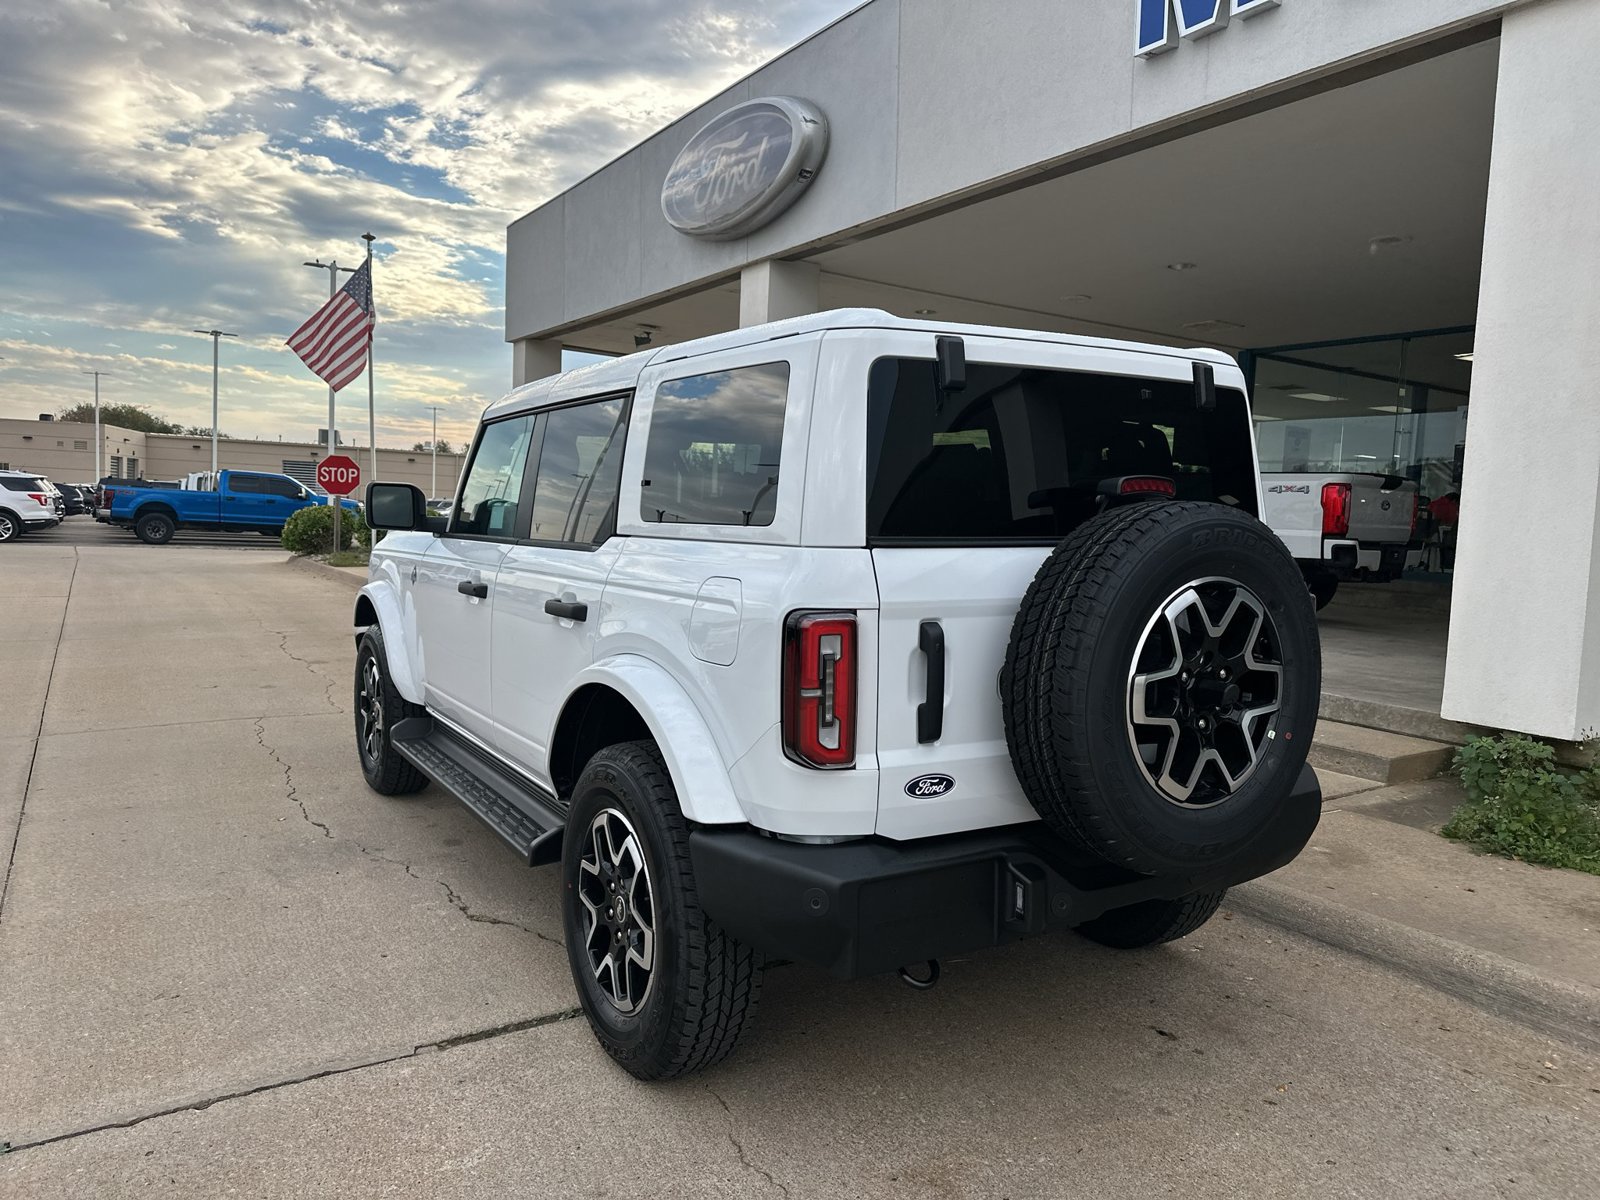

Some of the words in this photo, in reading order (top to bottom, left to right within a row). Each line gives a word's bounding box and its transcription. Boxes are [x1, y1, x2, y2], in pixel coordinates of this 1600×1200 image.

[694, 131, 769, 211] Ford
[320, 466, 358, 483] STOP
[915, 778, 947, 795] Ford
